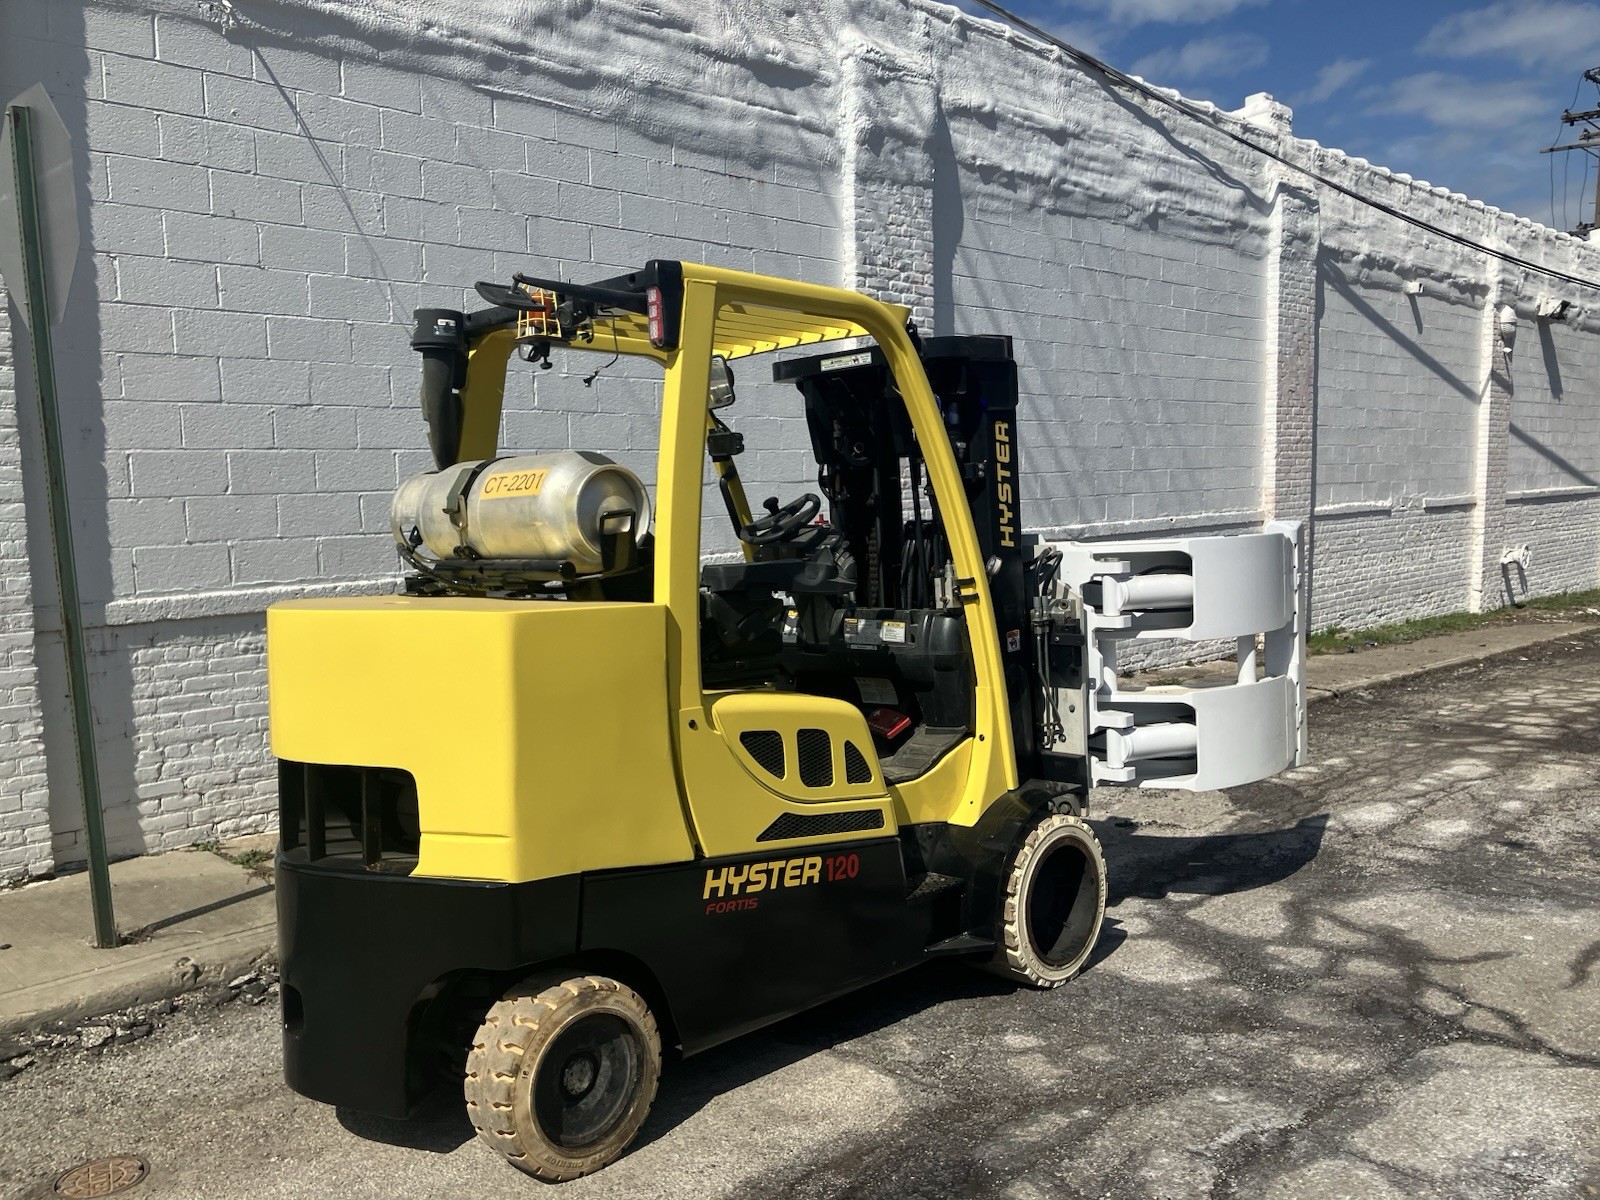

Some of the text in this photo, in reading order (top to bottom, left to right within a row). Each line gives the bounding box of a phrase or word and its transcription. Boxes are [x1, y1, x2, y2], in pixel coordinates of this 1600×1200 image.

[484, 473, 544, 494] CT-2201
[995, 421, 1015, 547] HYSTER
[703, 854, 859, 899] HYSTER 120
[706, 898, 758, 914] FORTIS
